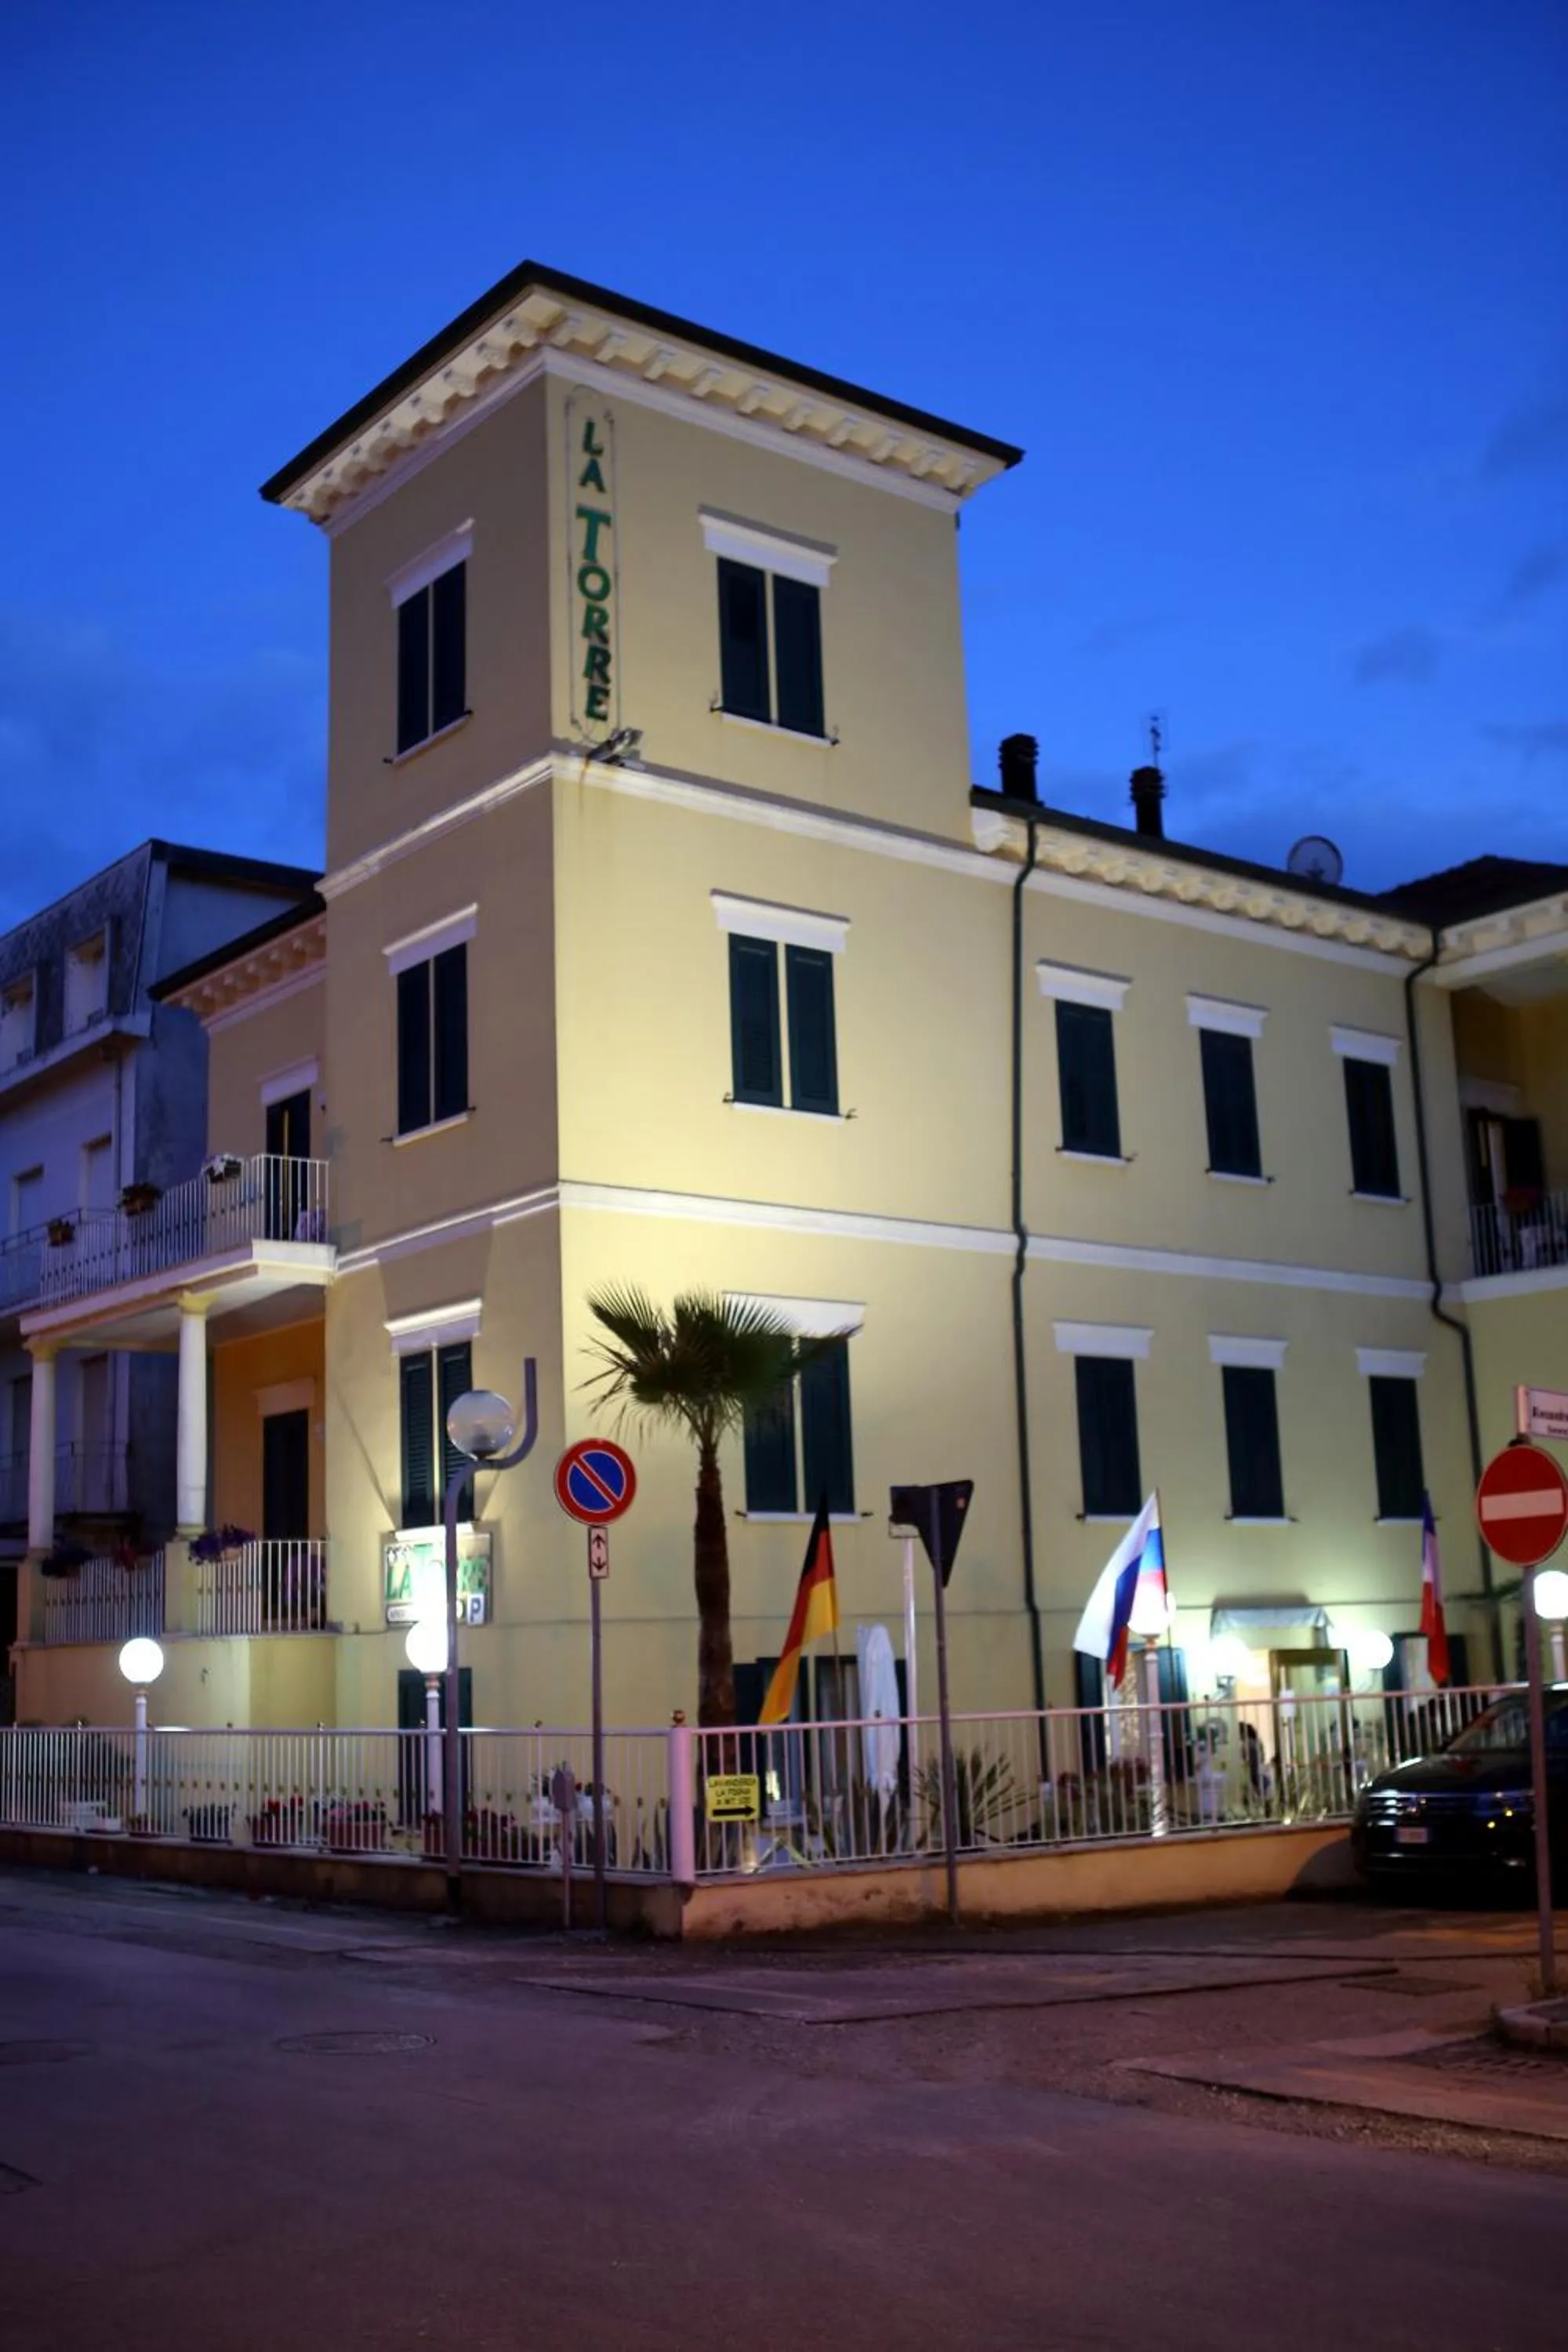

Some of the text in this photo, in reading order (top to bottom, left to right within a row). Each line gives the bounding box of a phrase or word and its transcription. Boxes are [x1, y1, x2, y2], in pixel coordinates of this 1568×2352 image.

[575, 417, 612, 721] LA TORRE
[385, 1564, 412, 1602] LA
[470, 1597, 481, 1622] P
